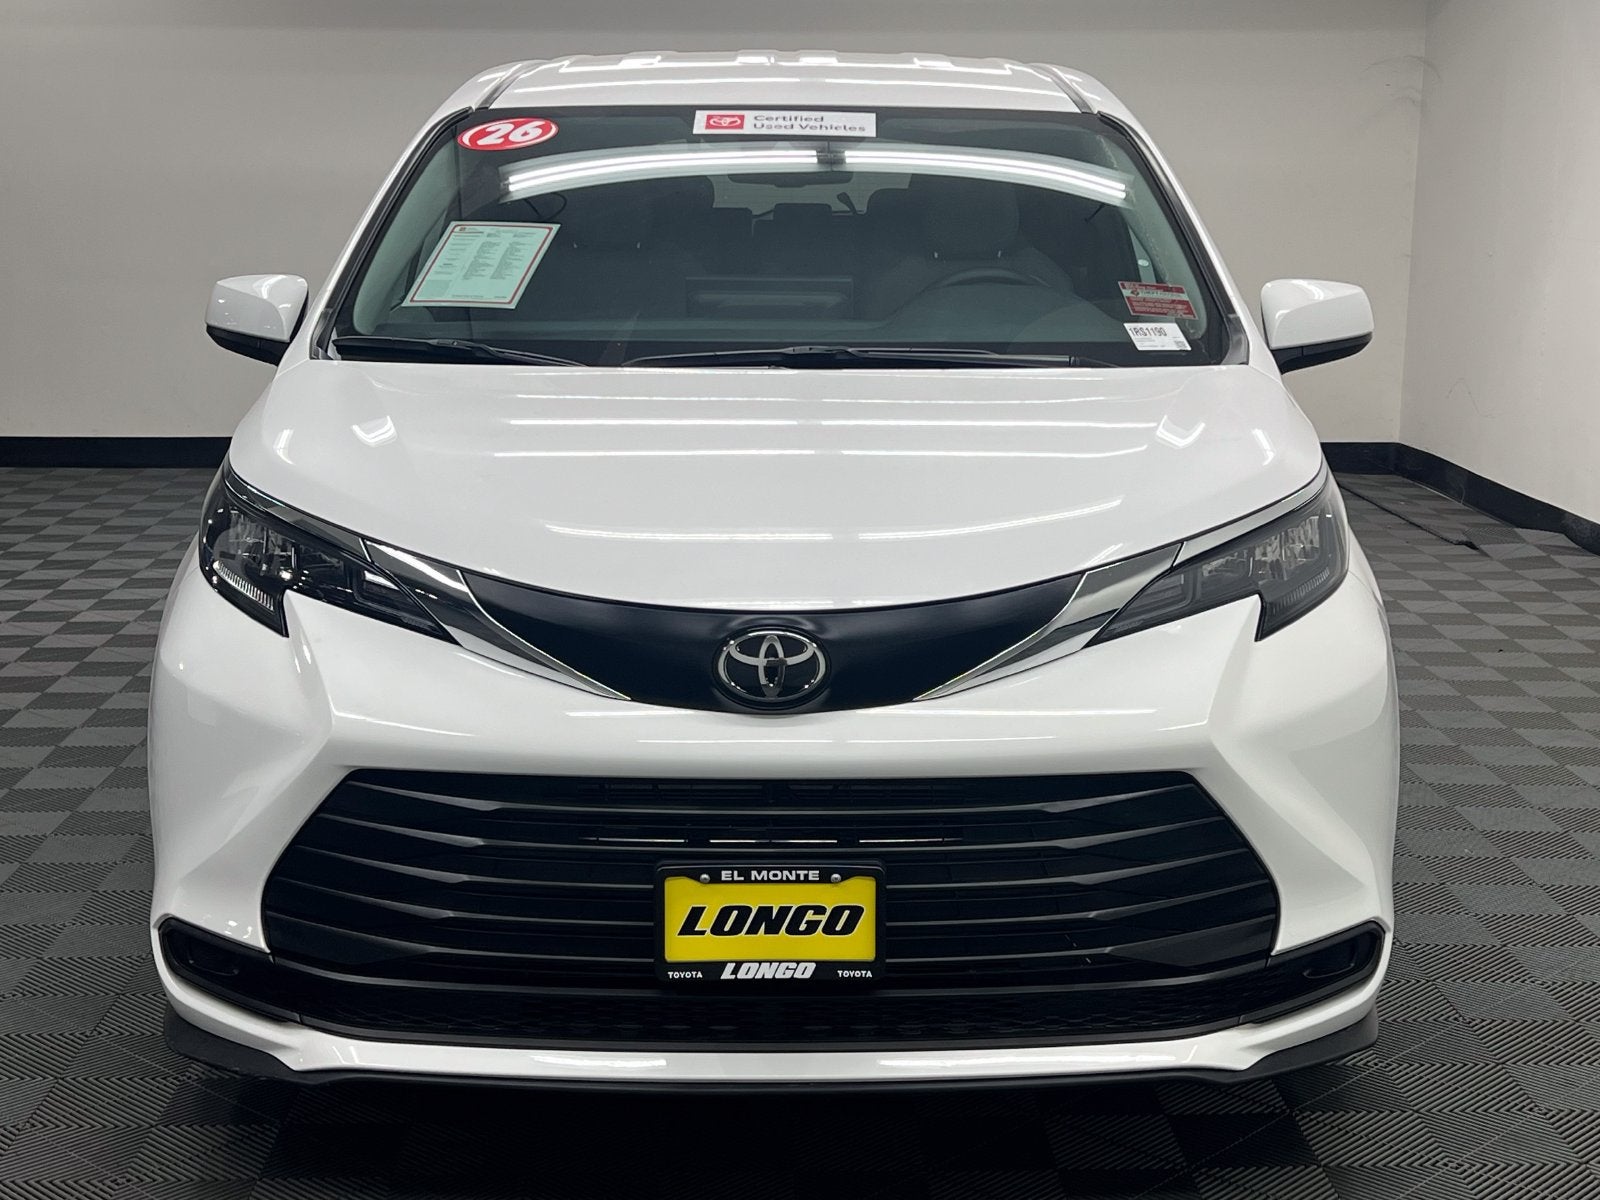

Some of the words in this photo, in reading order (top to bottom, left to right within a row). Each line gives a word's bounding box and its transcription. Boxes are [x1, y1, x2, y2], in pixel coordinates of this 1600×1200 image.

[753, 114, 825, 123] Certified
[799, 123, 867, 132] Vehicles
[476, 120, 546, 146] 26
[721, 870, 744, 881] EL
[751, 870, 820, 881] MONTE
[677, 905, 865, 936] LONGO
[668, 971, 703, 979] TOYOTA
[720, 962, 816, 980] LONGO
[837, 970, 873, 978] TOYOTA
